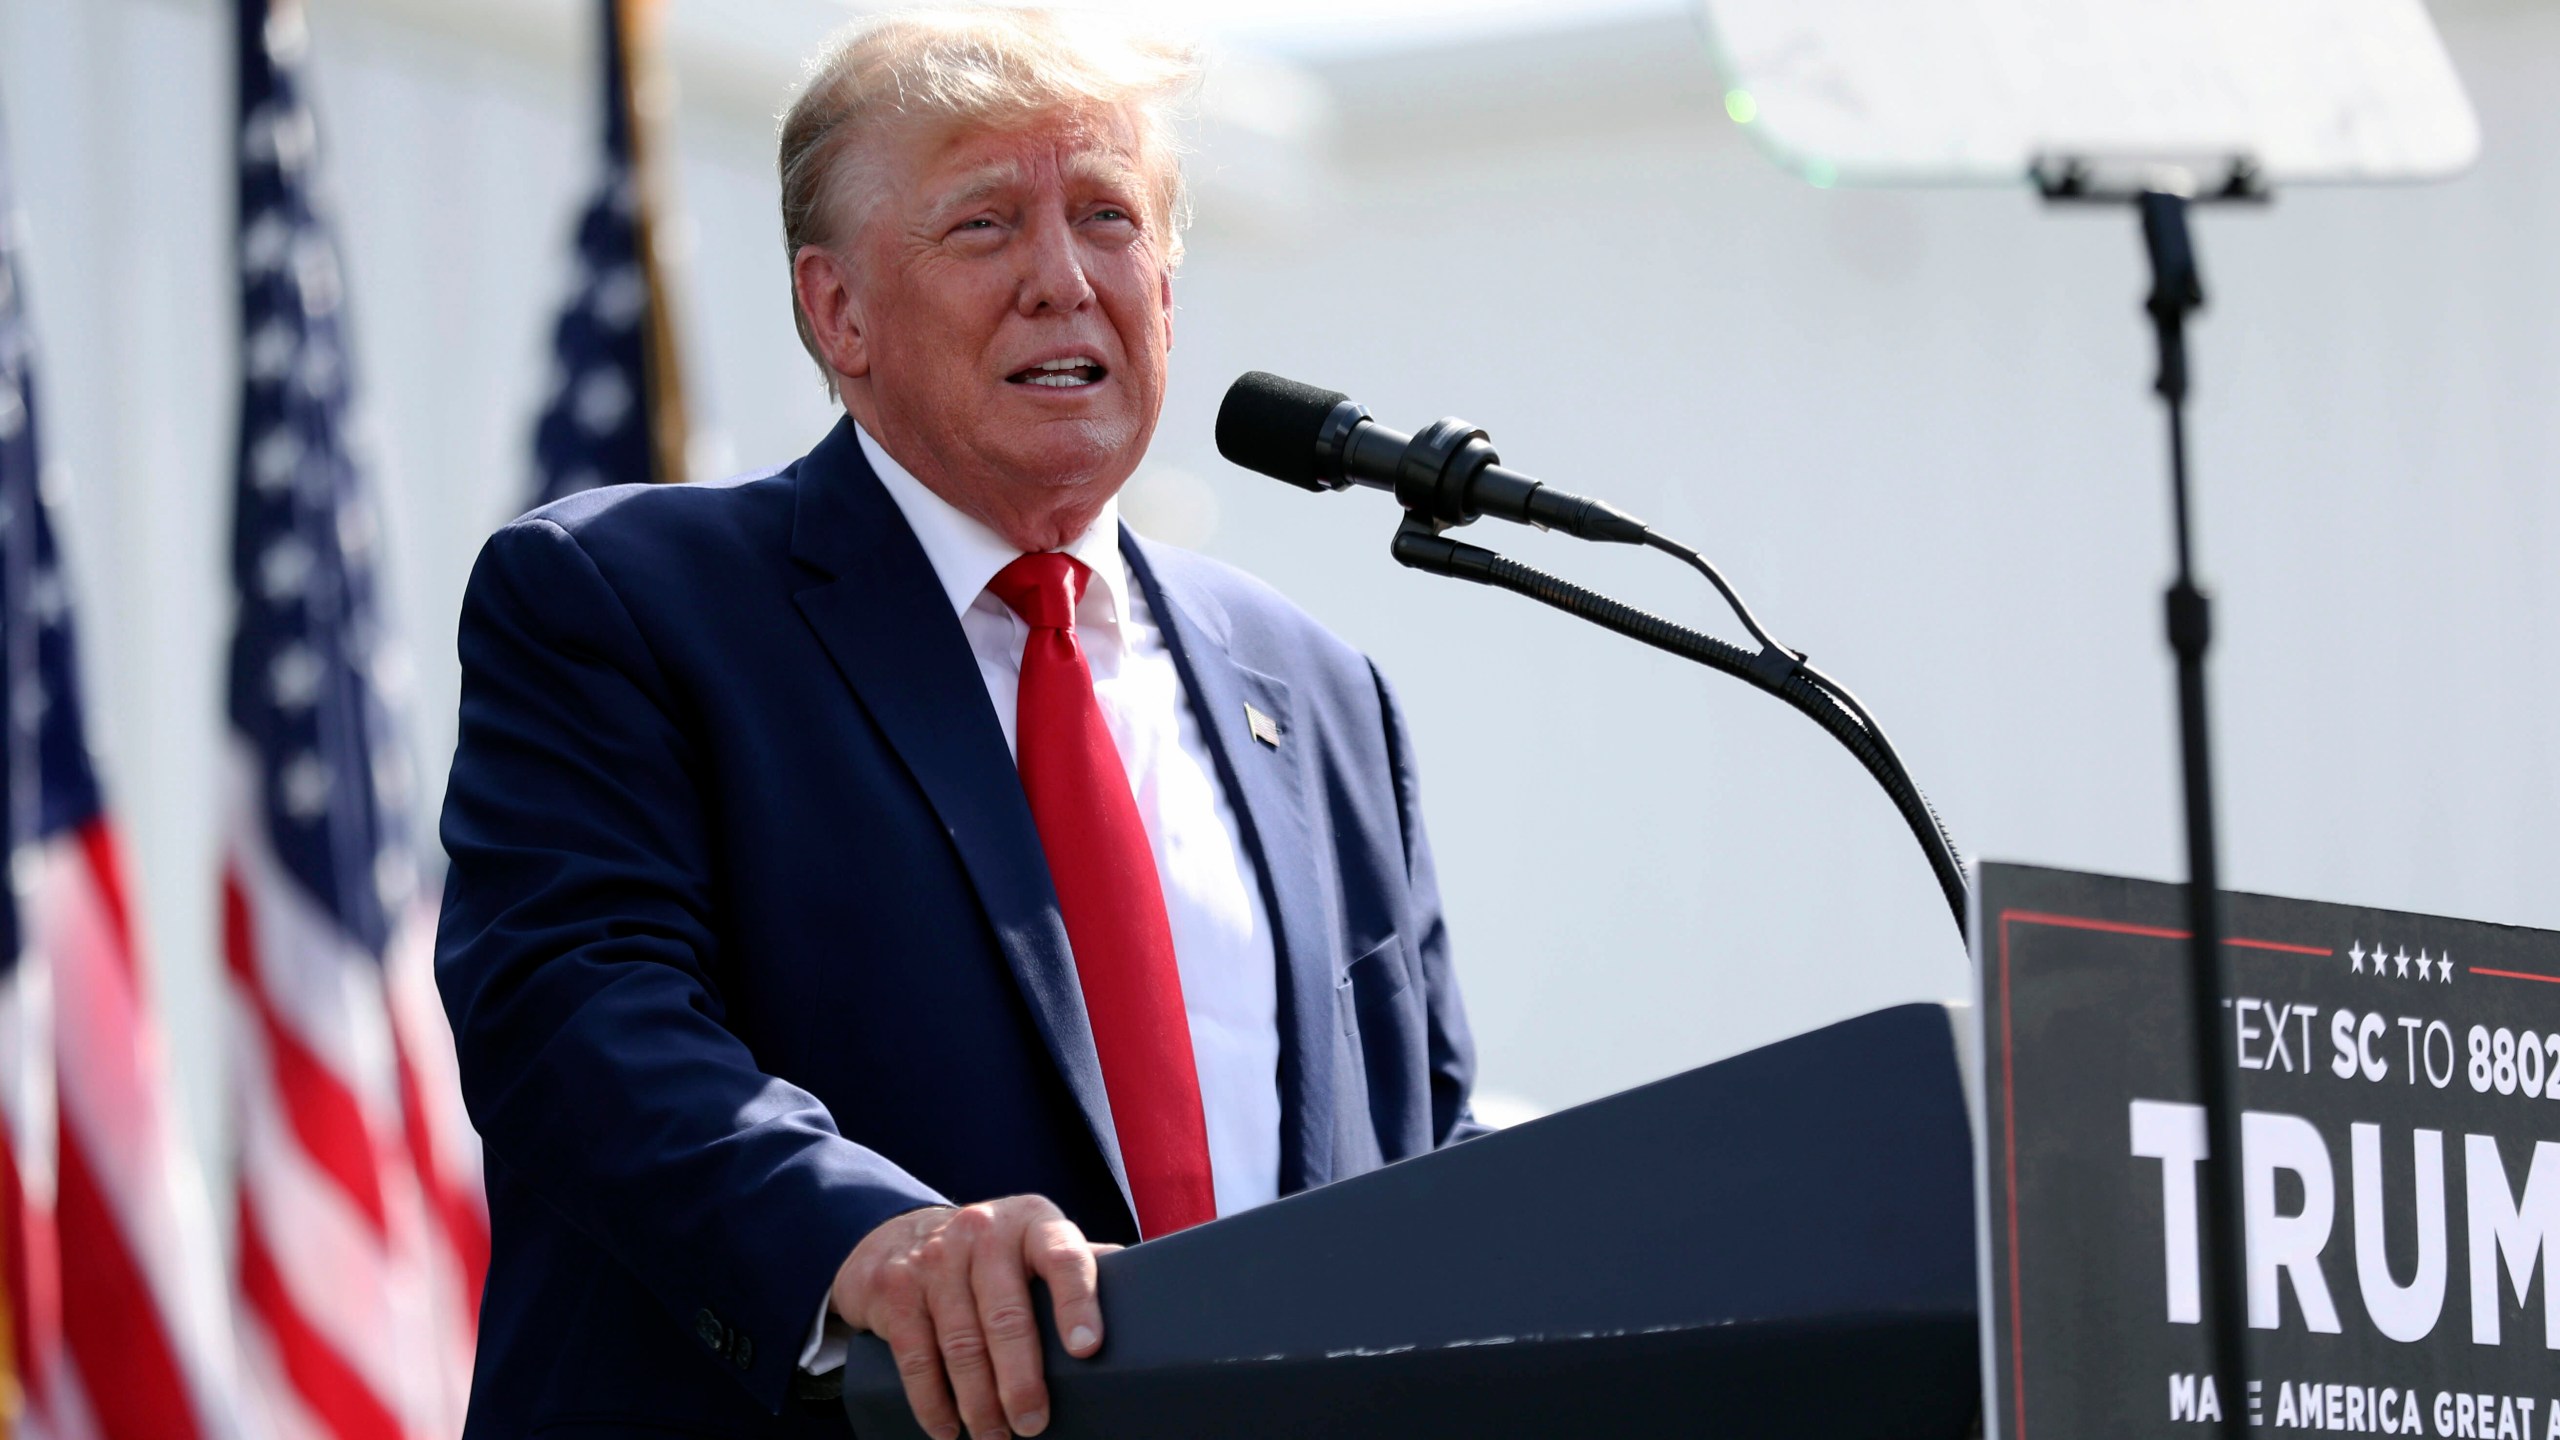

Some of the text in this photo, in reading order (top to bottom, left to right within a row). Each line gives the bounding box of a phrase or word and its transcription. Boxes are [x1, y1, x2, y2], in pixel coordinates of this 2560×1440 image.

[2221, 997, 2318, 1074] EXT
[2331, 1009, 2388, 1082] SC
[2398, 1017, 2454, 1088] TO
[2129, 1099, 2560, 1350] TRUM
[2169, 1373, 2263, 1425] MAE
[2275, 1381, 2423, 1435] AMERICA
[2434, 1391, 2534, 1440] GREAT
